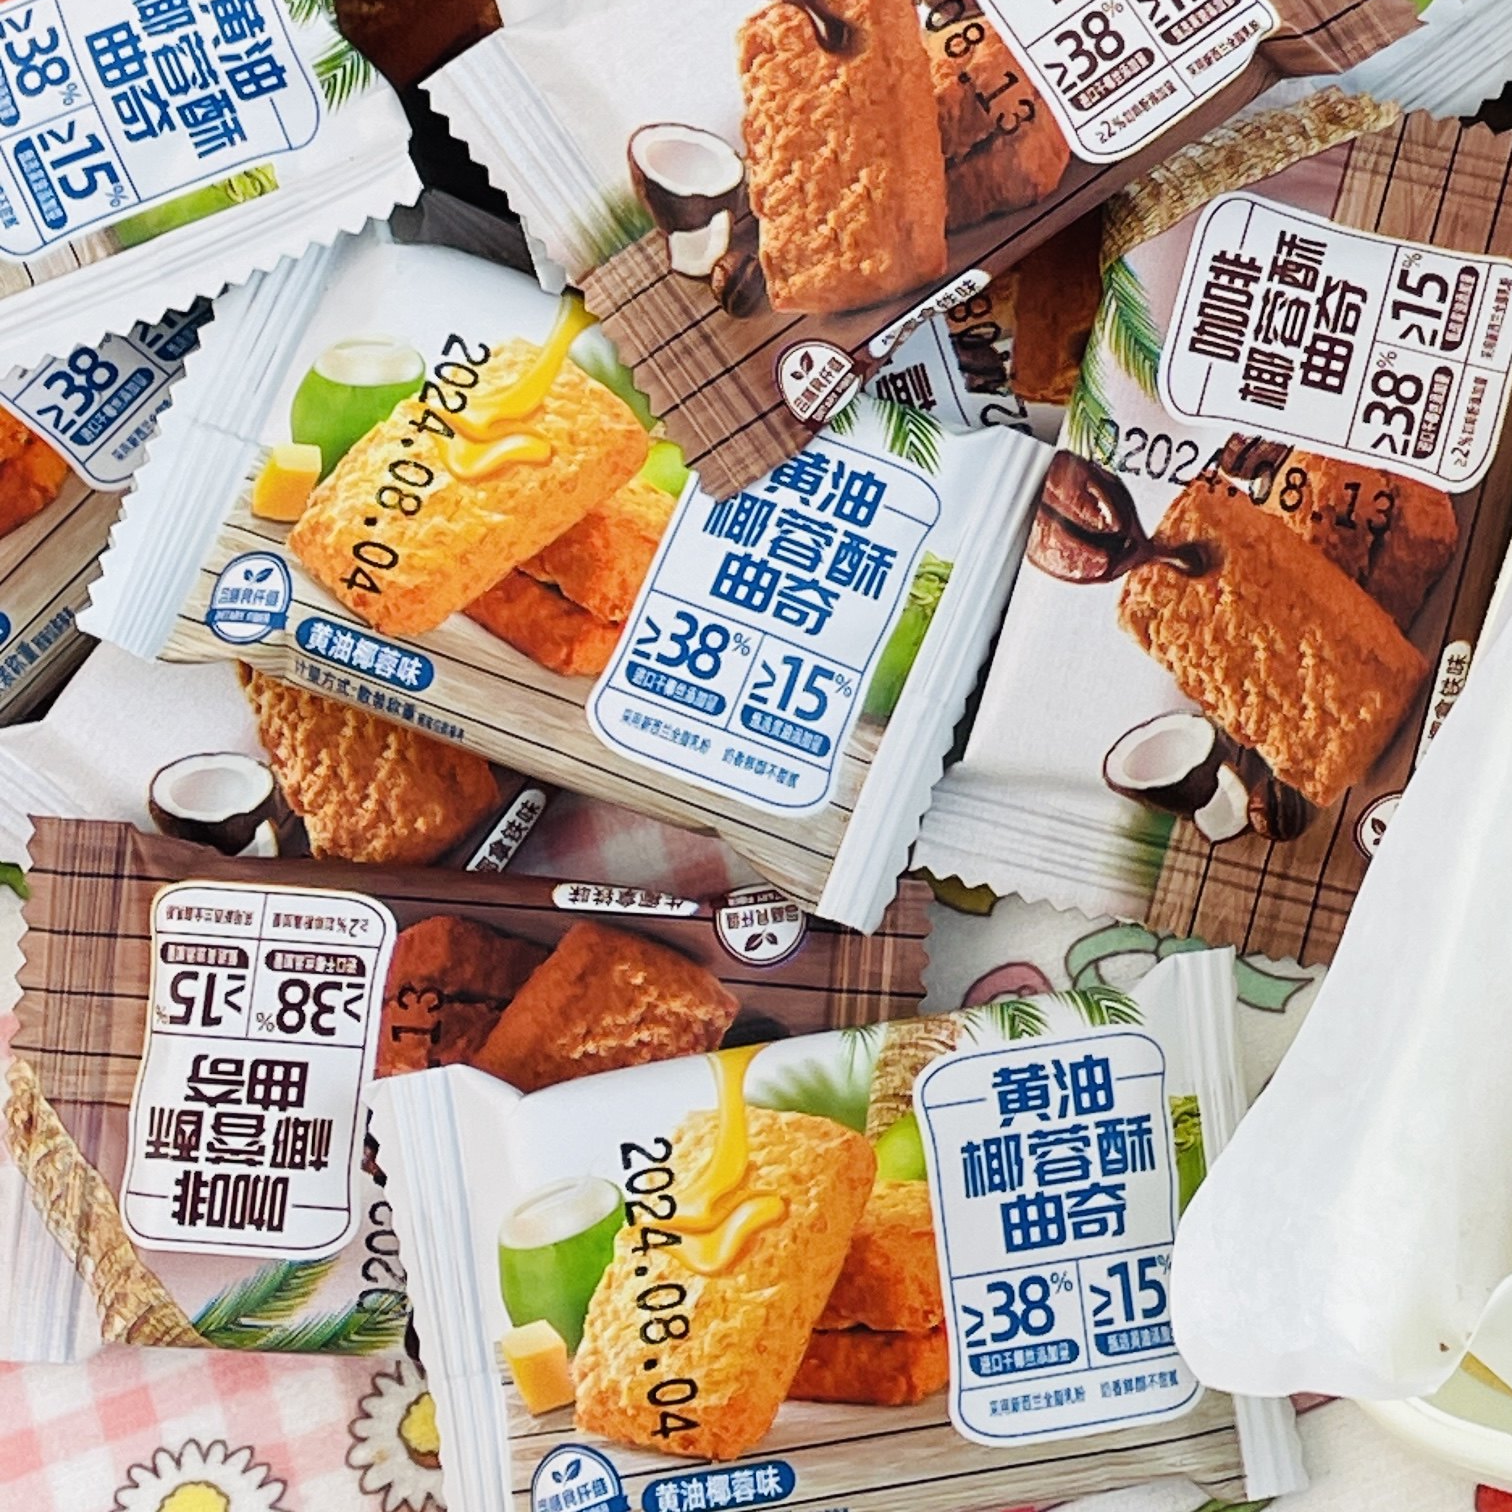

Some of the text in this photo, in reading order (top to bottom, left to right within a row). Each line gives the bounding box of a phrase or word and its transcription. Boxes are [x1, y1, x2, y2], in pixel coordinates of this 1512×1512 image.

[86, 20, 177, 142] 曲奇
[36, 120, 129, 208] ≥15%
[1189, 250, 1263, 363] 咖啡
[1239, 231, 1328, 410] 椰蓉酥
[1300, 276, 1368, 394] 曲奇
[1392, 253, 1449, 346] ≥15%
[1362, 351, 1424, 457] ≥38%
[340, 333, 491, 594] 2024.08.04
[764, 450, 888, 528] 黄油
[703, 492, 897, 600] 椰蓉酥
[710, 552, 840, 635] 曲奇
[305, 622, 422, 685] 黄油椰蓉味
[632, 611, 751, 680] ≥38%
[750, 655, 852, 721] ≥15%
[155, 971, 246, 1027] ≥15%
[256, 979, 365, 1036] ≥38%
[184, 1054, 308, 1110] 曲奇
[991, 1055, 1114, 1128] 黄油
[145, 1107, 332, 1170] 椰蓉酥
[961, 1114, 1156, 1199] 椰蓉酥
[171, 1170, 290, 1232] 咖啡
[1000, 1183, 1127, 1254] 曲奇
[620, 1137, 700, 1439] 2024.08.04
[961, 1271, 1074, 1348] ≥38%
[655, 1465, 783, 1511] 黄油椰蓉味
